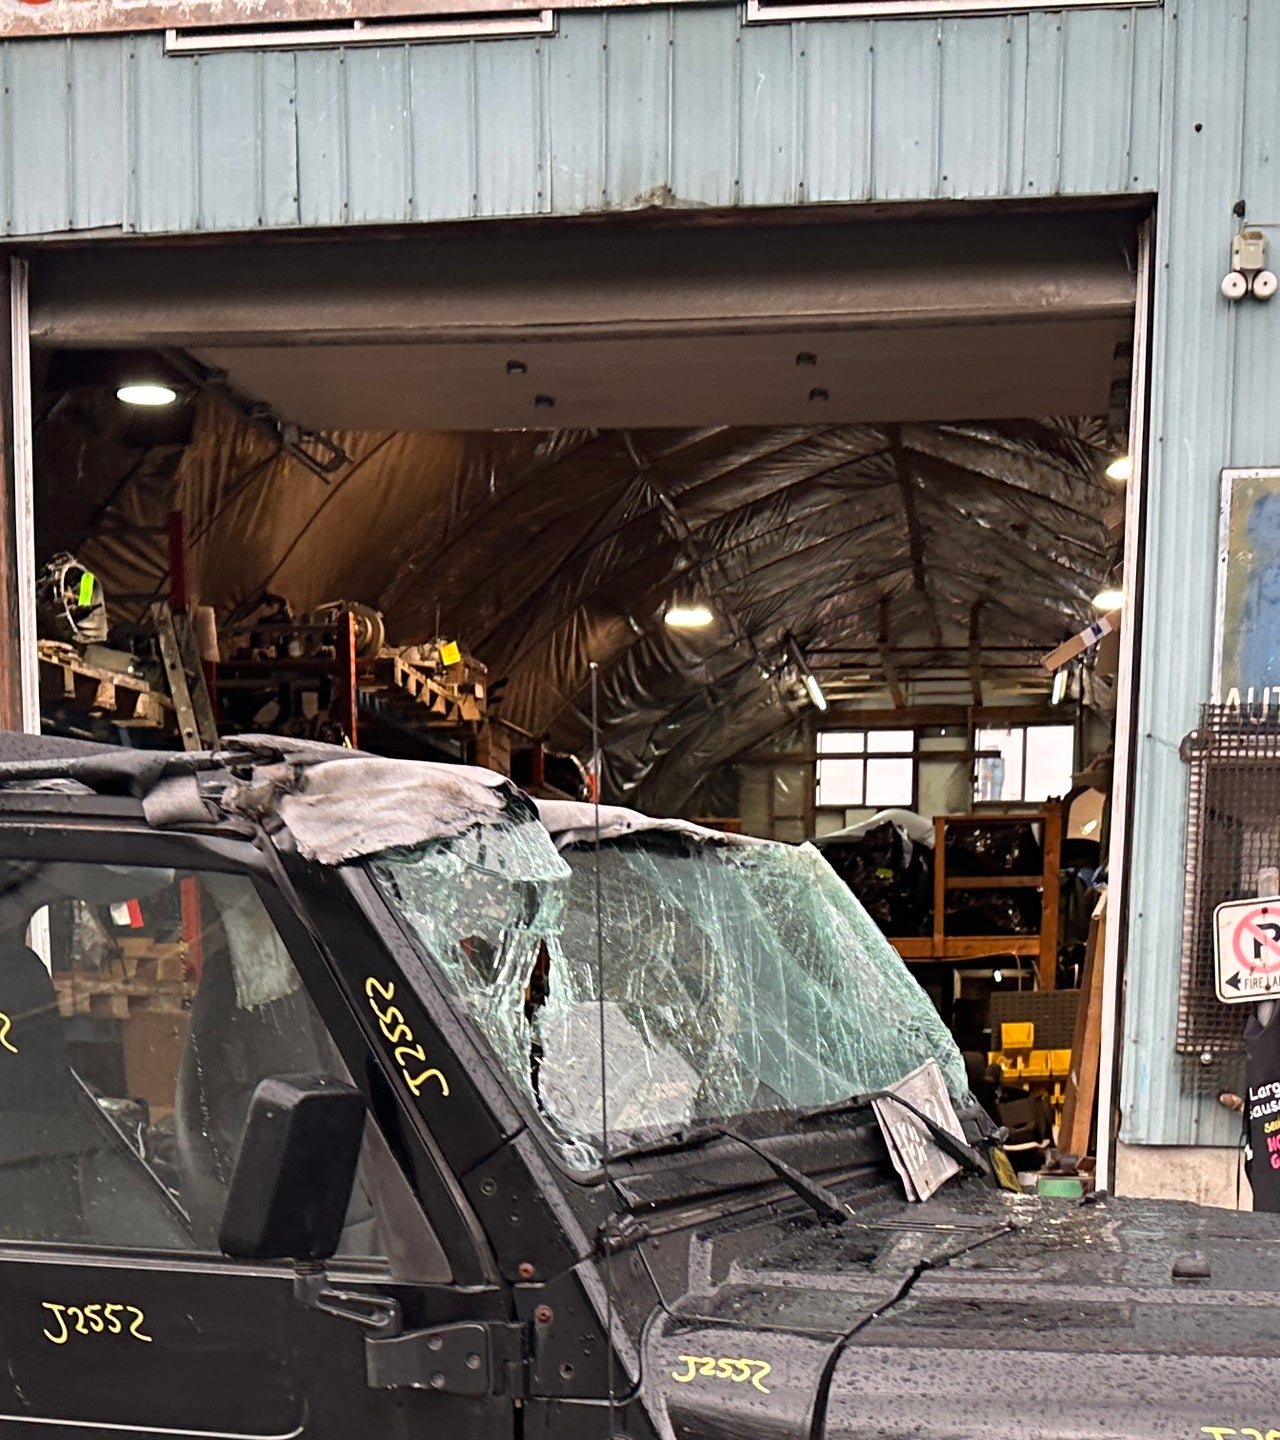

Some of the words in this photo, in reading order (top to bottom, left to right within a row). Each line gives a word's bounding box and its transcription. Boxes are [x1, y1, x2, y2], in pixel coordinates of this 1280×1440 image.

[1244, 976, 1265, 990] FIRE
[365, 976, 450, 1097] J2552
[42, 1301, 153, 1344] J2552
[671, 1355, 772, 1394] J2552
